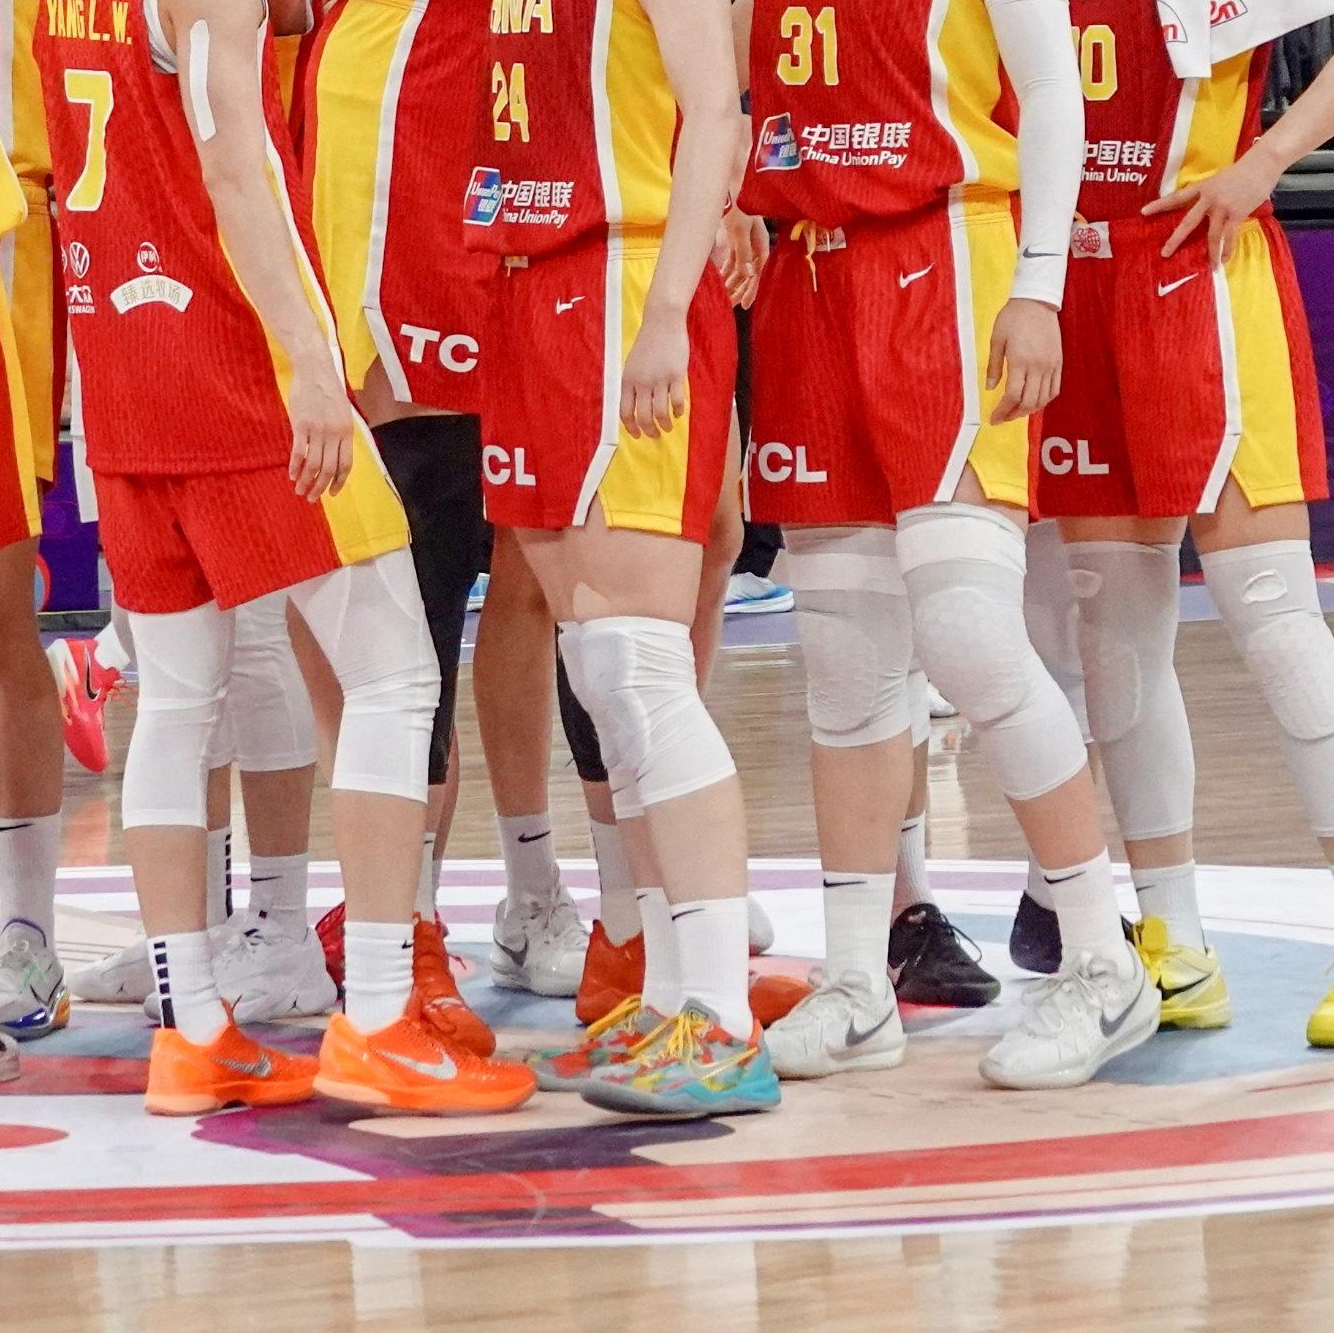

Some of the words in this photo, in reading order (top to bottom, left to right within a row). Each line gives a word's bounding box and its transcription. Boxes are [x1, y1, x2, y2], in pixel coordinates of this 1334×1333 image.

[777, 6, 839, 86] 31
[492, 62, 530, 143] 24
[64, 68, 114, 211] 7
[801, 122, 912, 150] 中国银联
[800, 146, 840, 166] China
[842, 150, 907, 168] UnionPay
[1080, 167, 1103, 182] hina
[502, 180, 575, 208] 中国银联
[518, 210, 569, 229] UnionPay
[400, 324, 479, 373] TC
[483, 444, 536, 486] CL
[1041, 436, 1110, 476] CL
